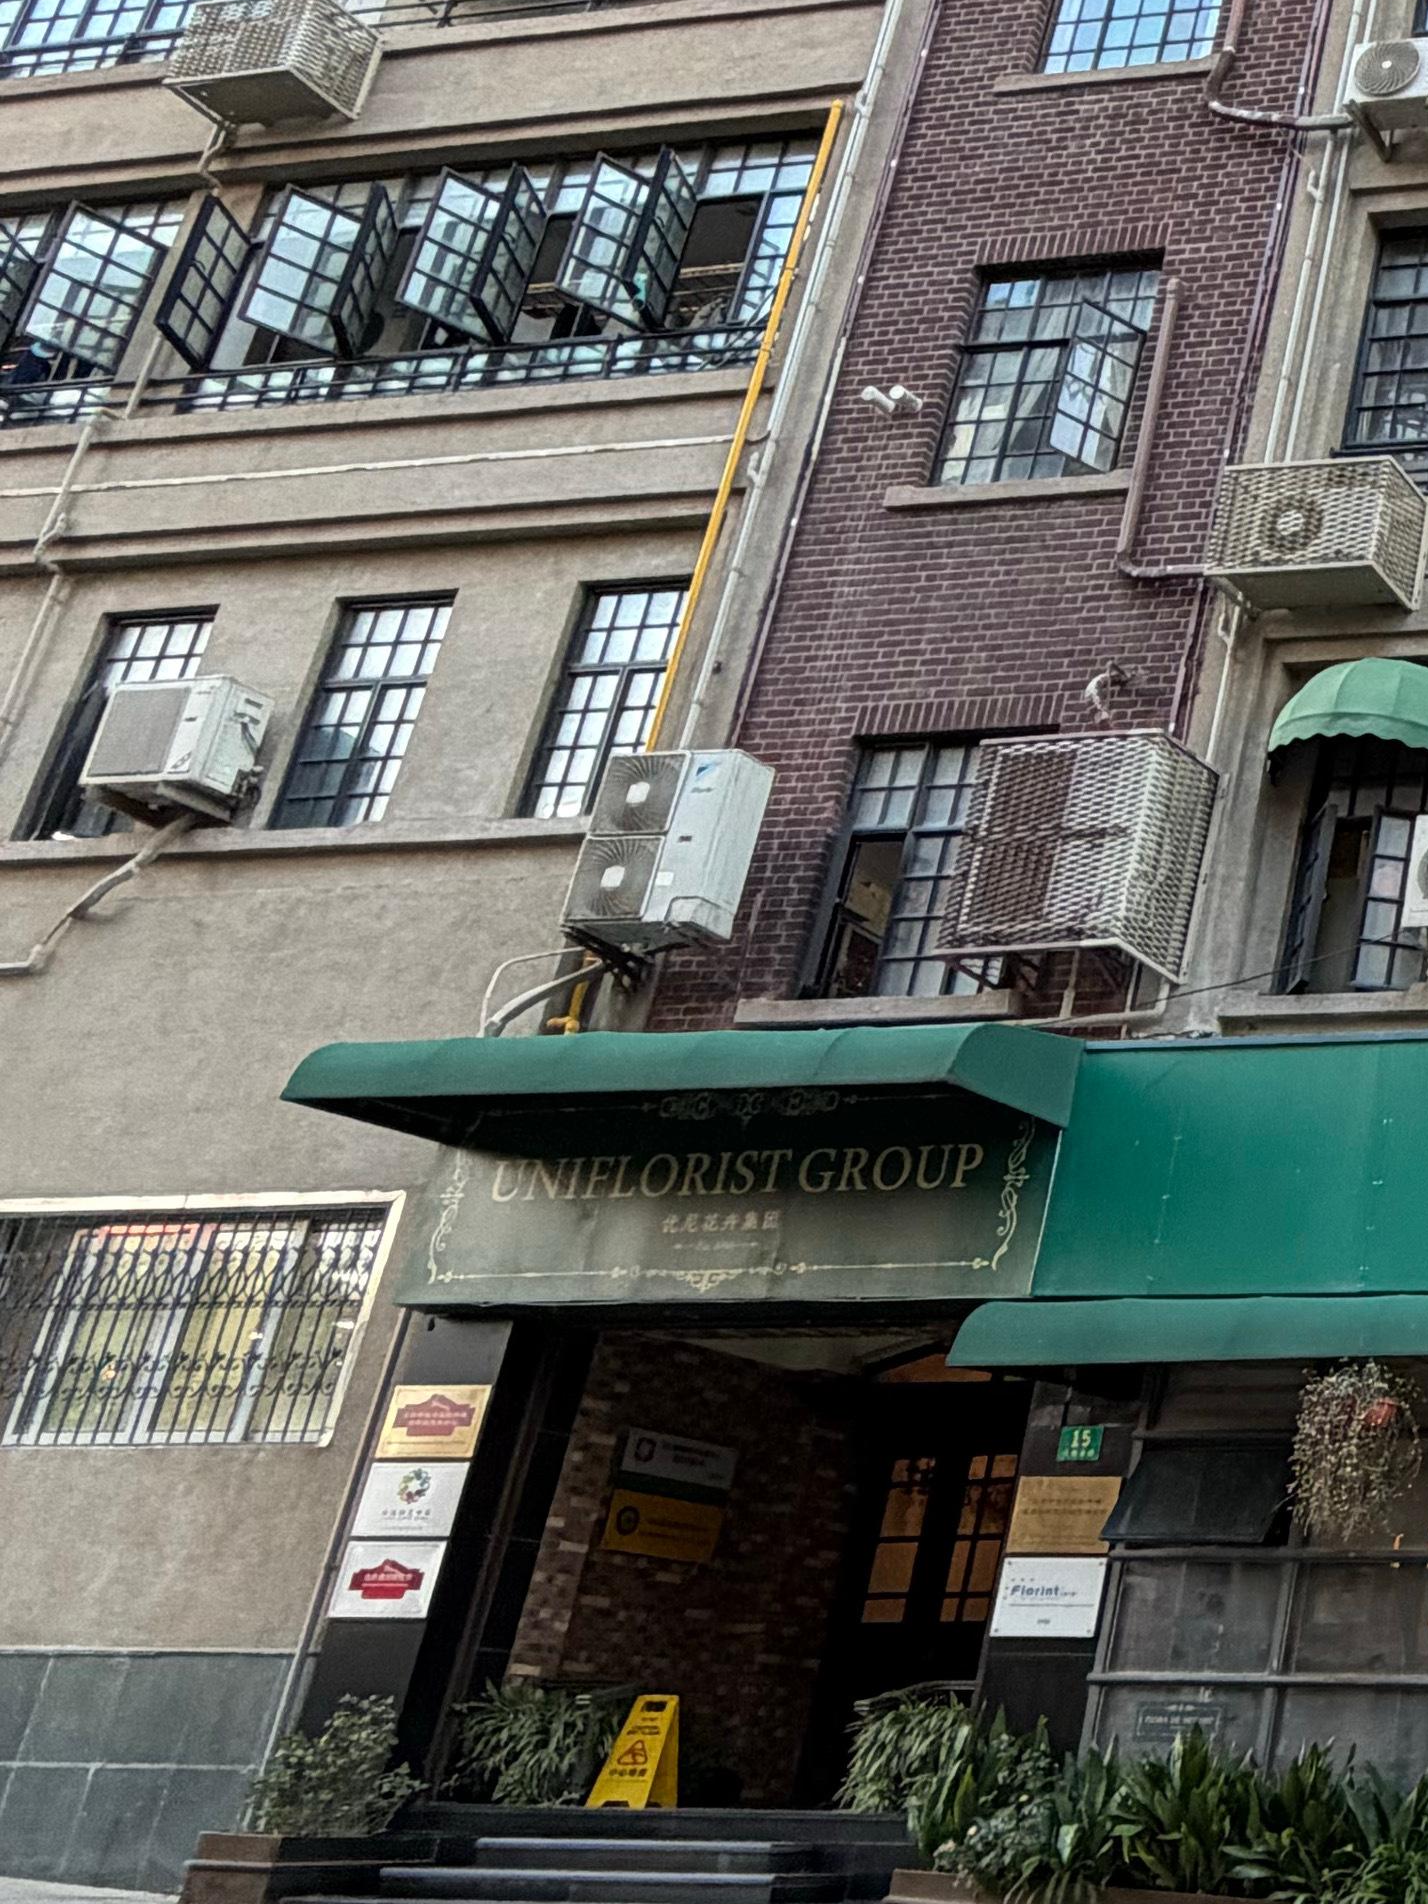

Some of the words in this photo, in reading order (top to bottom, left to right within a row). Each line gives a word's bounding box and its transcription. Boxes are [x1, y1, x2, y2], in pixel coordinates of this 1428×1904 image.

[491, 1148, 794, 1202] UNIFLORIST
[799, 1143, 985, 1194] GROUP
[1070, 1429, 1092, 1449] 15
